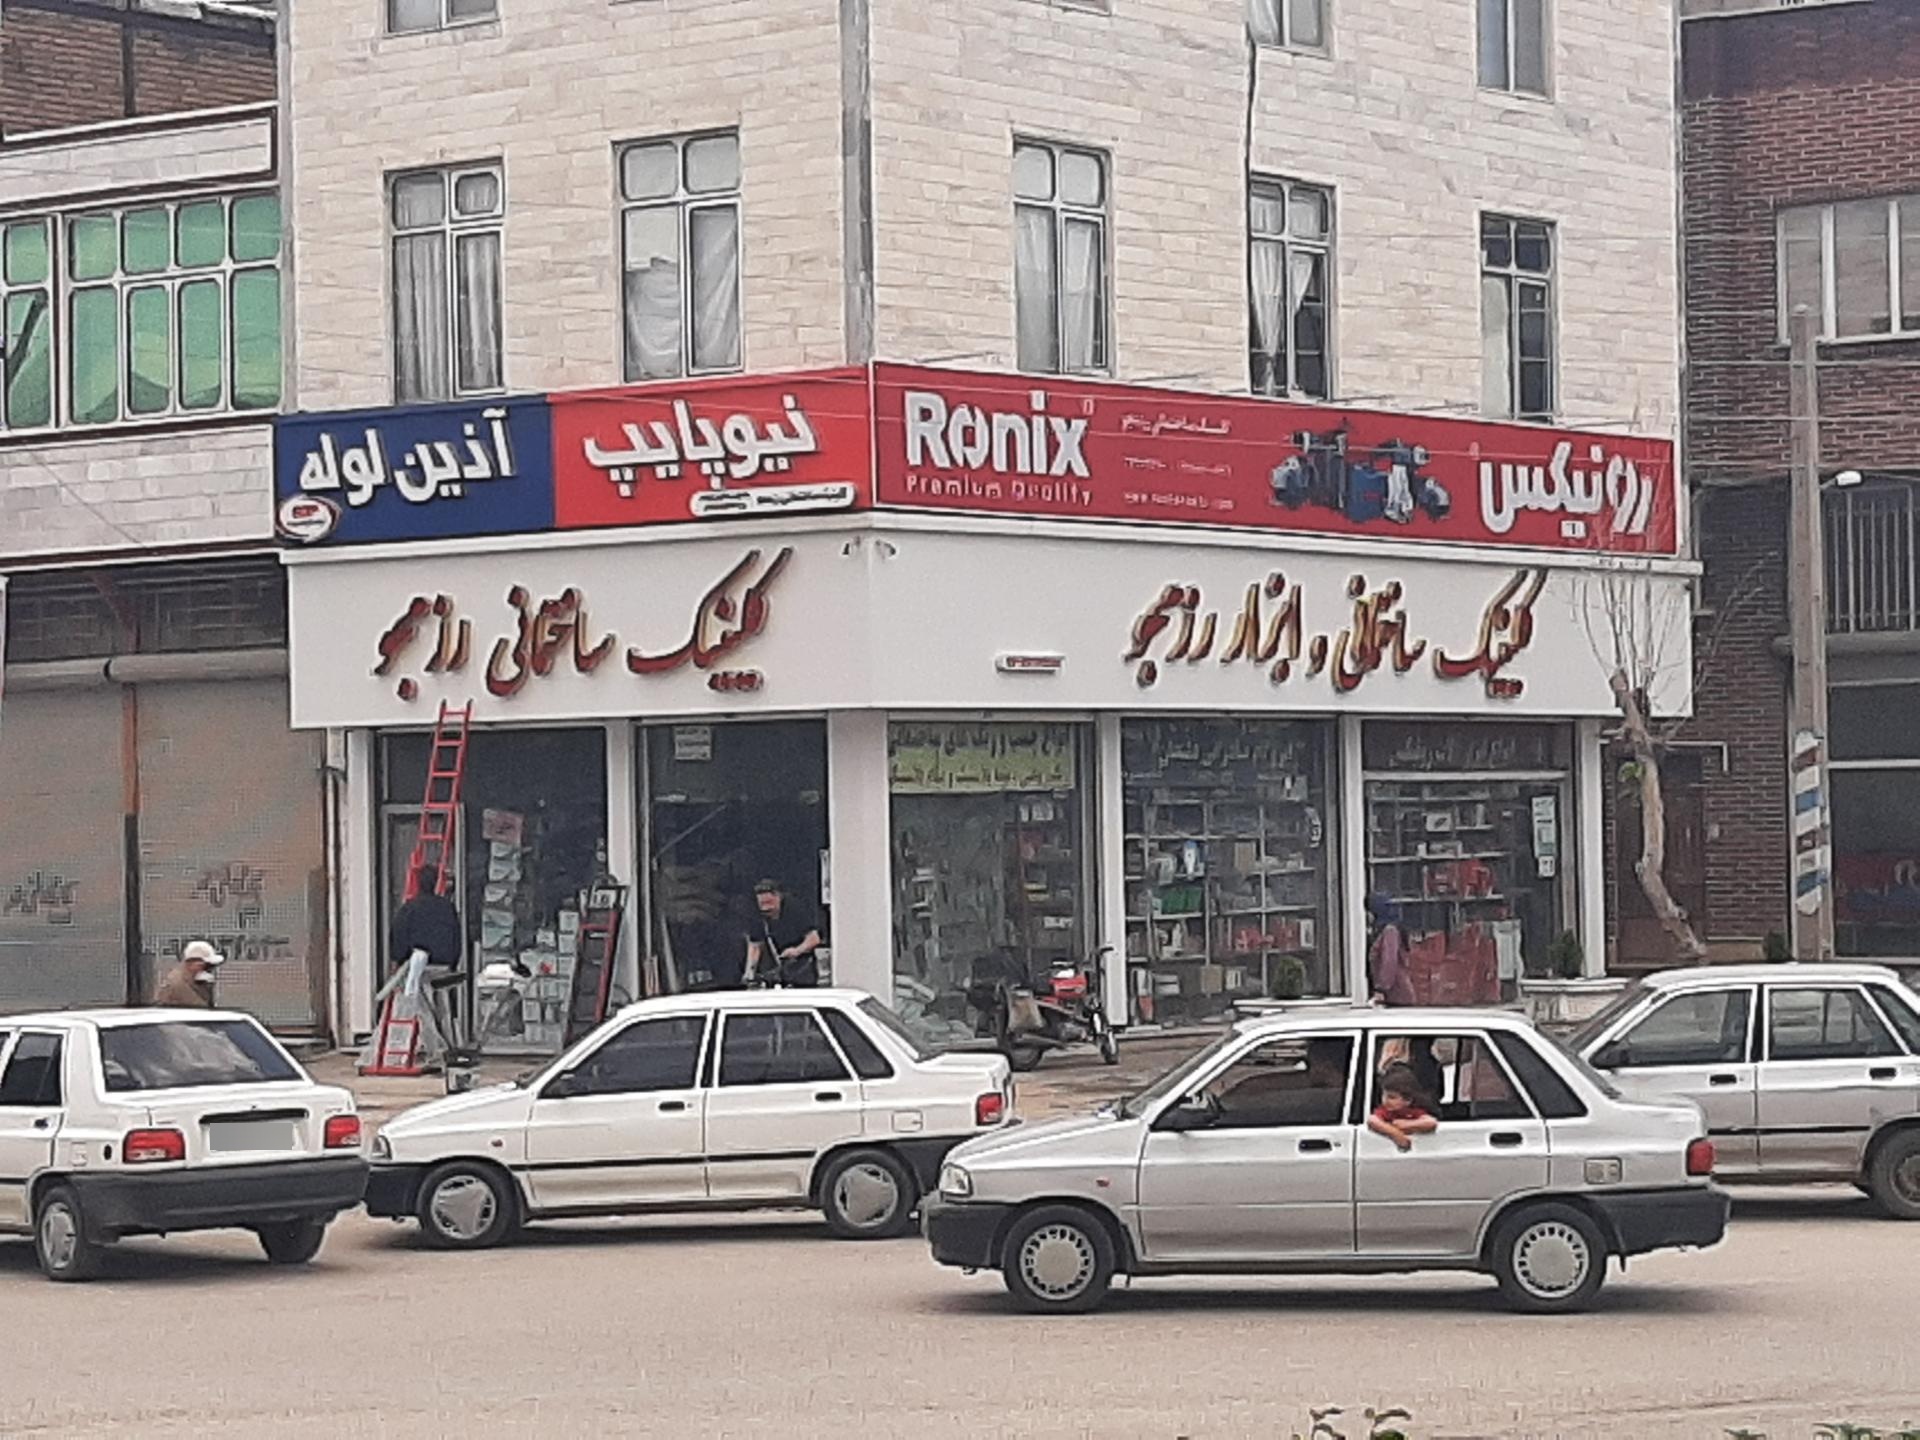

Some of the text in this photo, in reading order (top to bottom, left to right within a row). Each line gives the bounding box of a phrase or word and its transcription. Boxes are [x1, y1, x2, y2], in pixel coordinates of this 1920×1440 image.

[299, 406, 516, 508] آذین لوله
[583, 394, 817, 498] نیوپایپ
[904, 389, 1091, 479] Ronix
[906, 474, 1003, 501] Premium
[1010, 479, 1093, 508] Quality
[1479, 440, 1654, 539] رونیکس
[485, 584, 618, 698] ساختمانی
[626, 547, 794, 692] کلینیک
[1432, 567, 1551, 699] کلینیک
